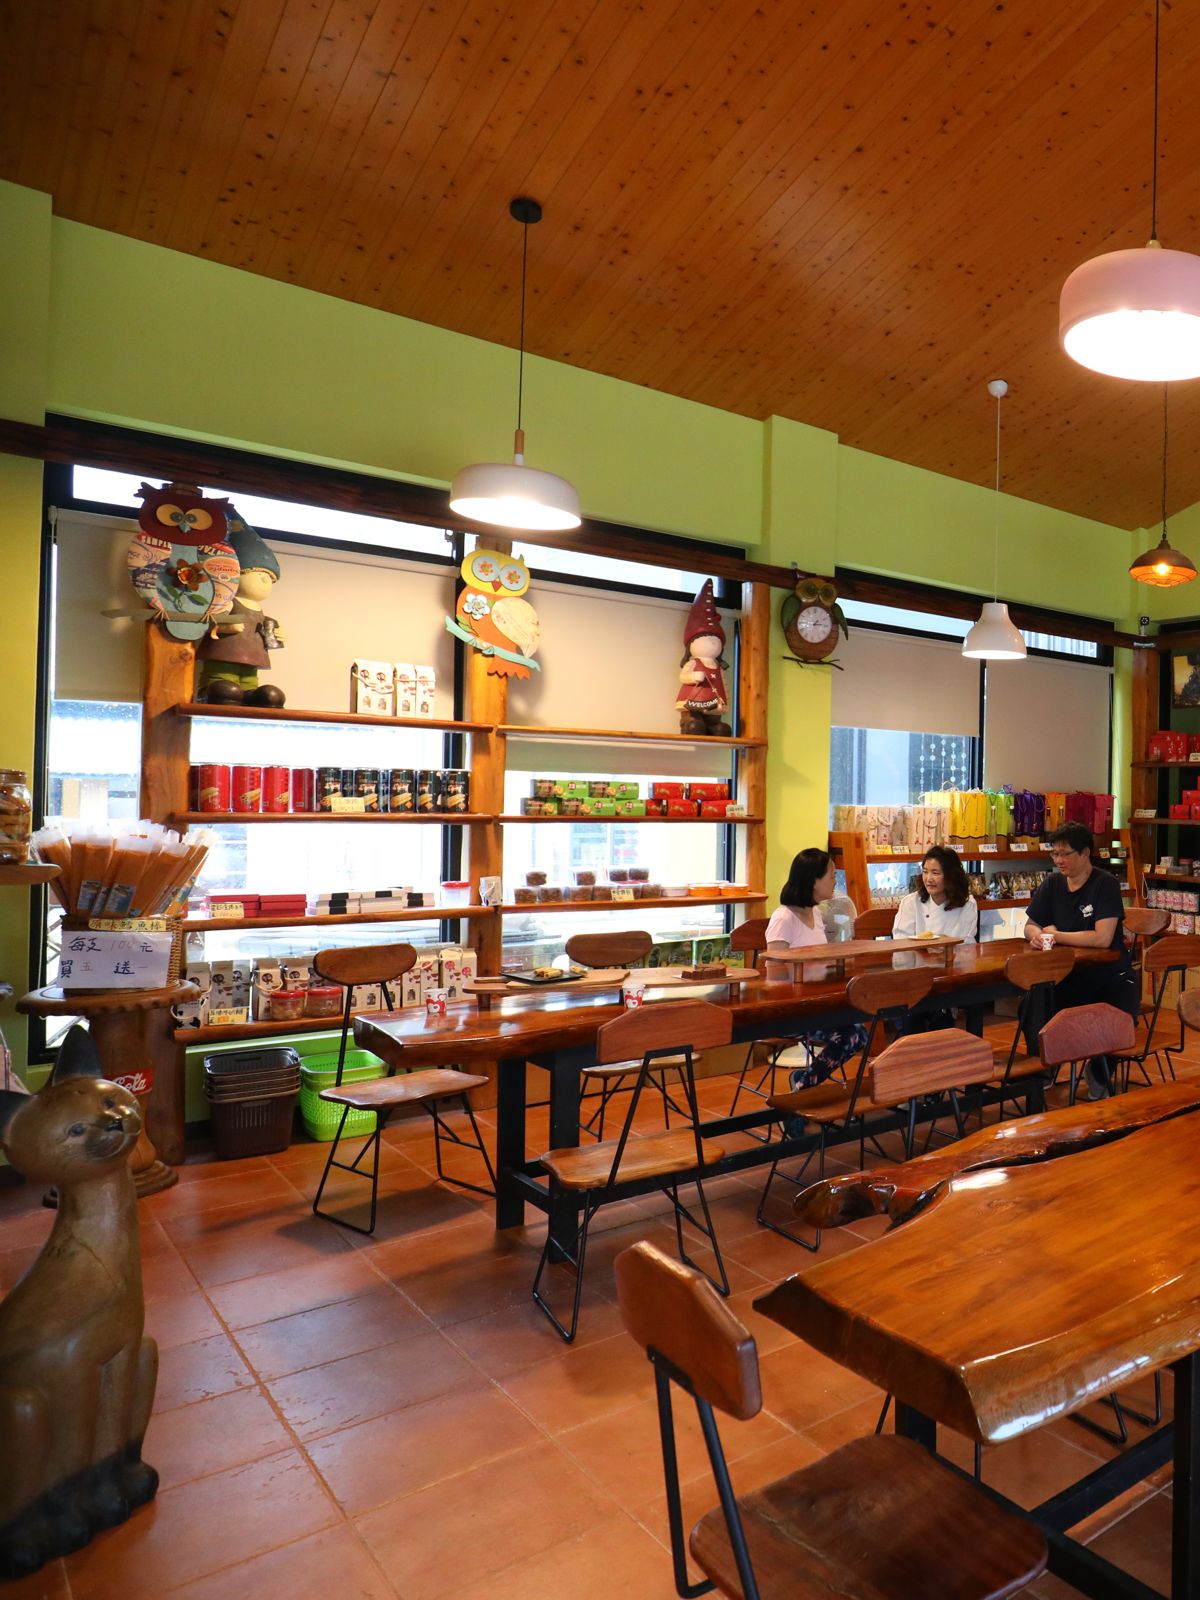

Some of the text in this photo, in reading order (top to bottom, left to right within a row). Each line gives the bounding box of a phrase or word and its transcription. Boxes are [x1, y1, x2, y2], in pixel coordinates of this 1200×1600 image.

[688, 698, 717, 708] WELCOME
[139, 942, 153, 953] 元
[60, 959, 74, 979] 買
[80, 961, 93, 972] 五
[113, 960, 136, 975] 送
